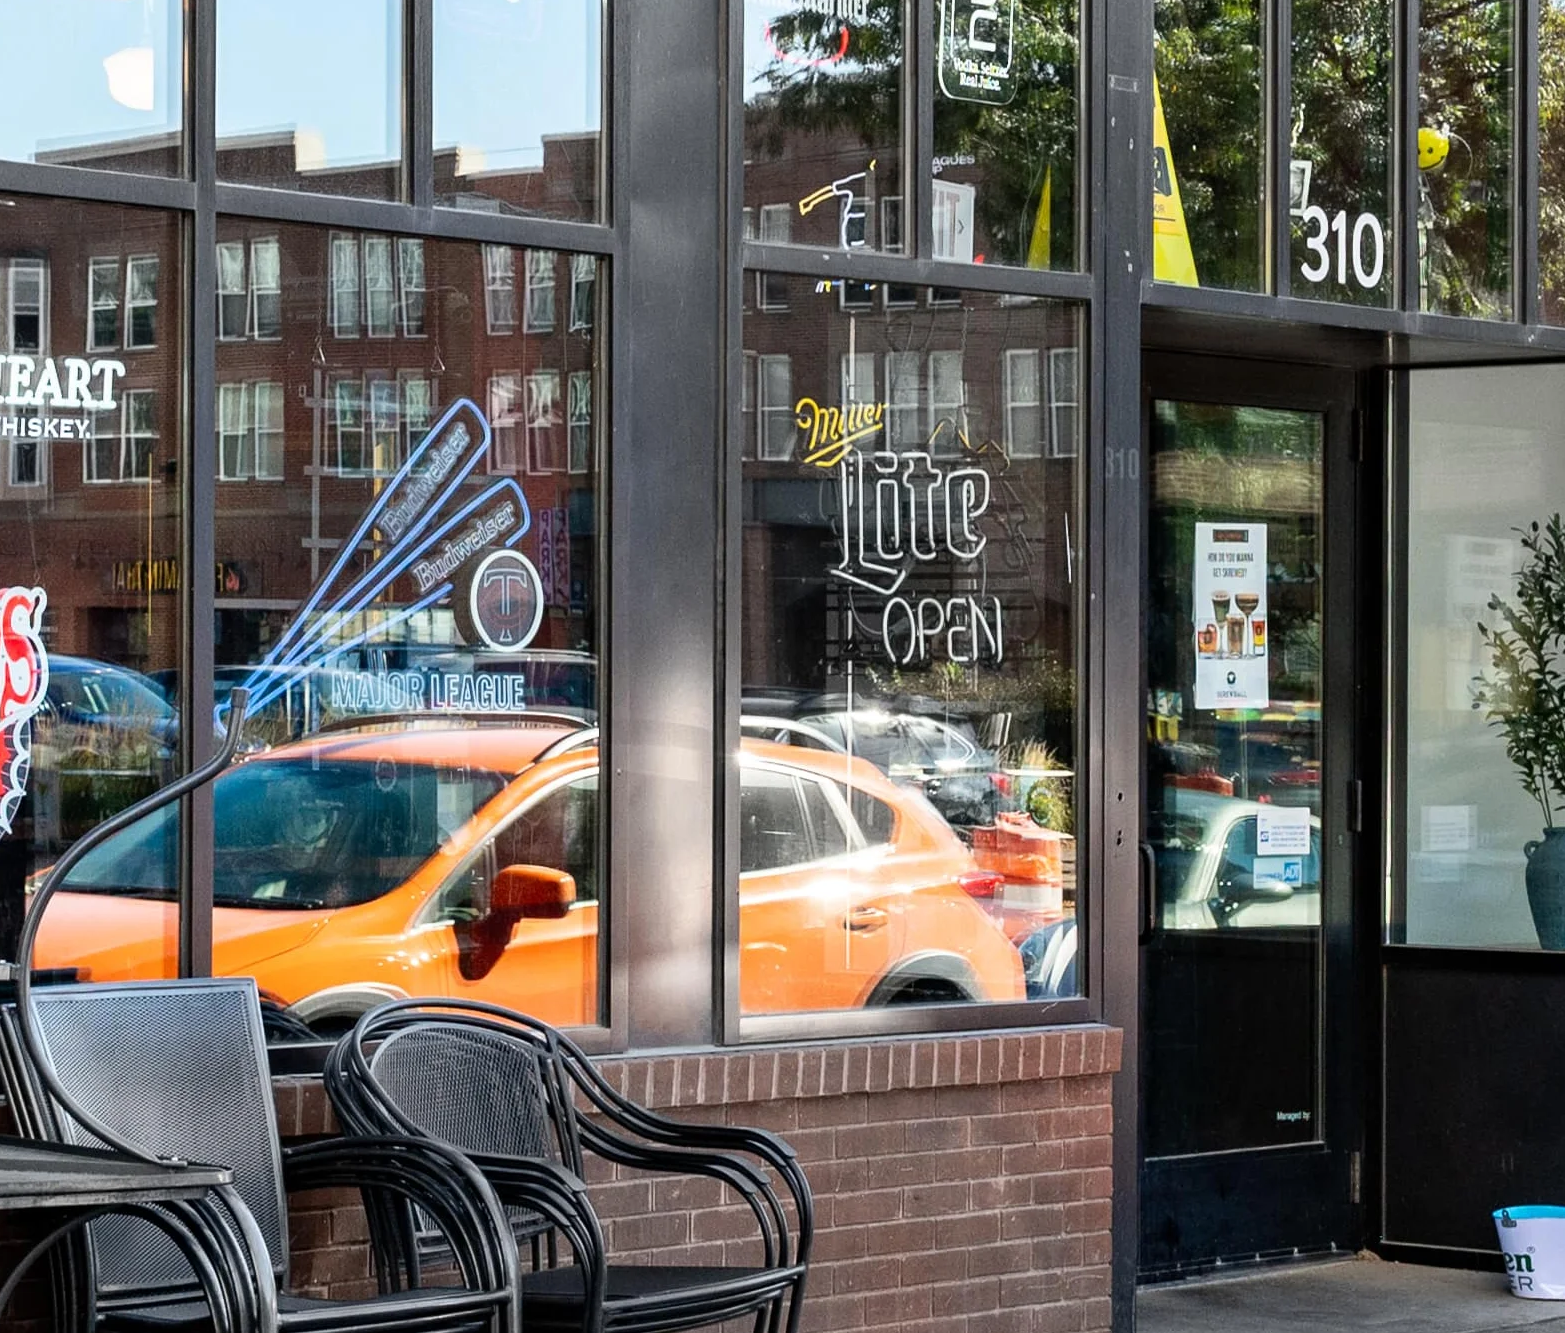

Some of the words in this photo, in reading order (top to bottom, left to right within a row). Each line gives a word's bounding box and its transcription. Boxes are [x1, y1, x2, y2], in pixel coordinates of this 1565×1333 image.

[1301, 205, 1384, 289] 310
[795, 397, 889, 453] Miller
[379, 420, 471, 543] Budweiser
[831, 449, 990, 594] Lite
[413, 501, 516, 593] Budweiser
[883, 594, 1003, 665] OPEN
[332, 671, 424, 709] MAJOR
[431, 673, 525, 711] LEAGUE
